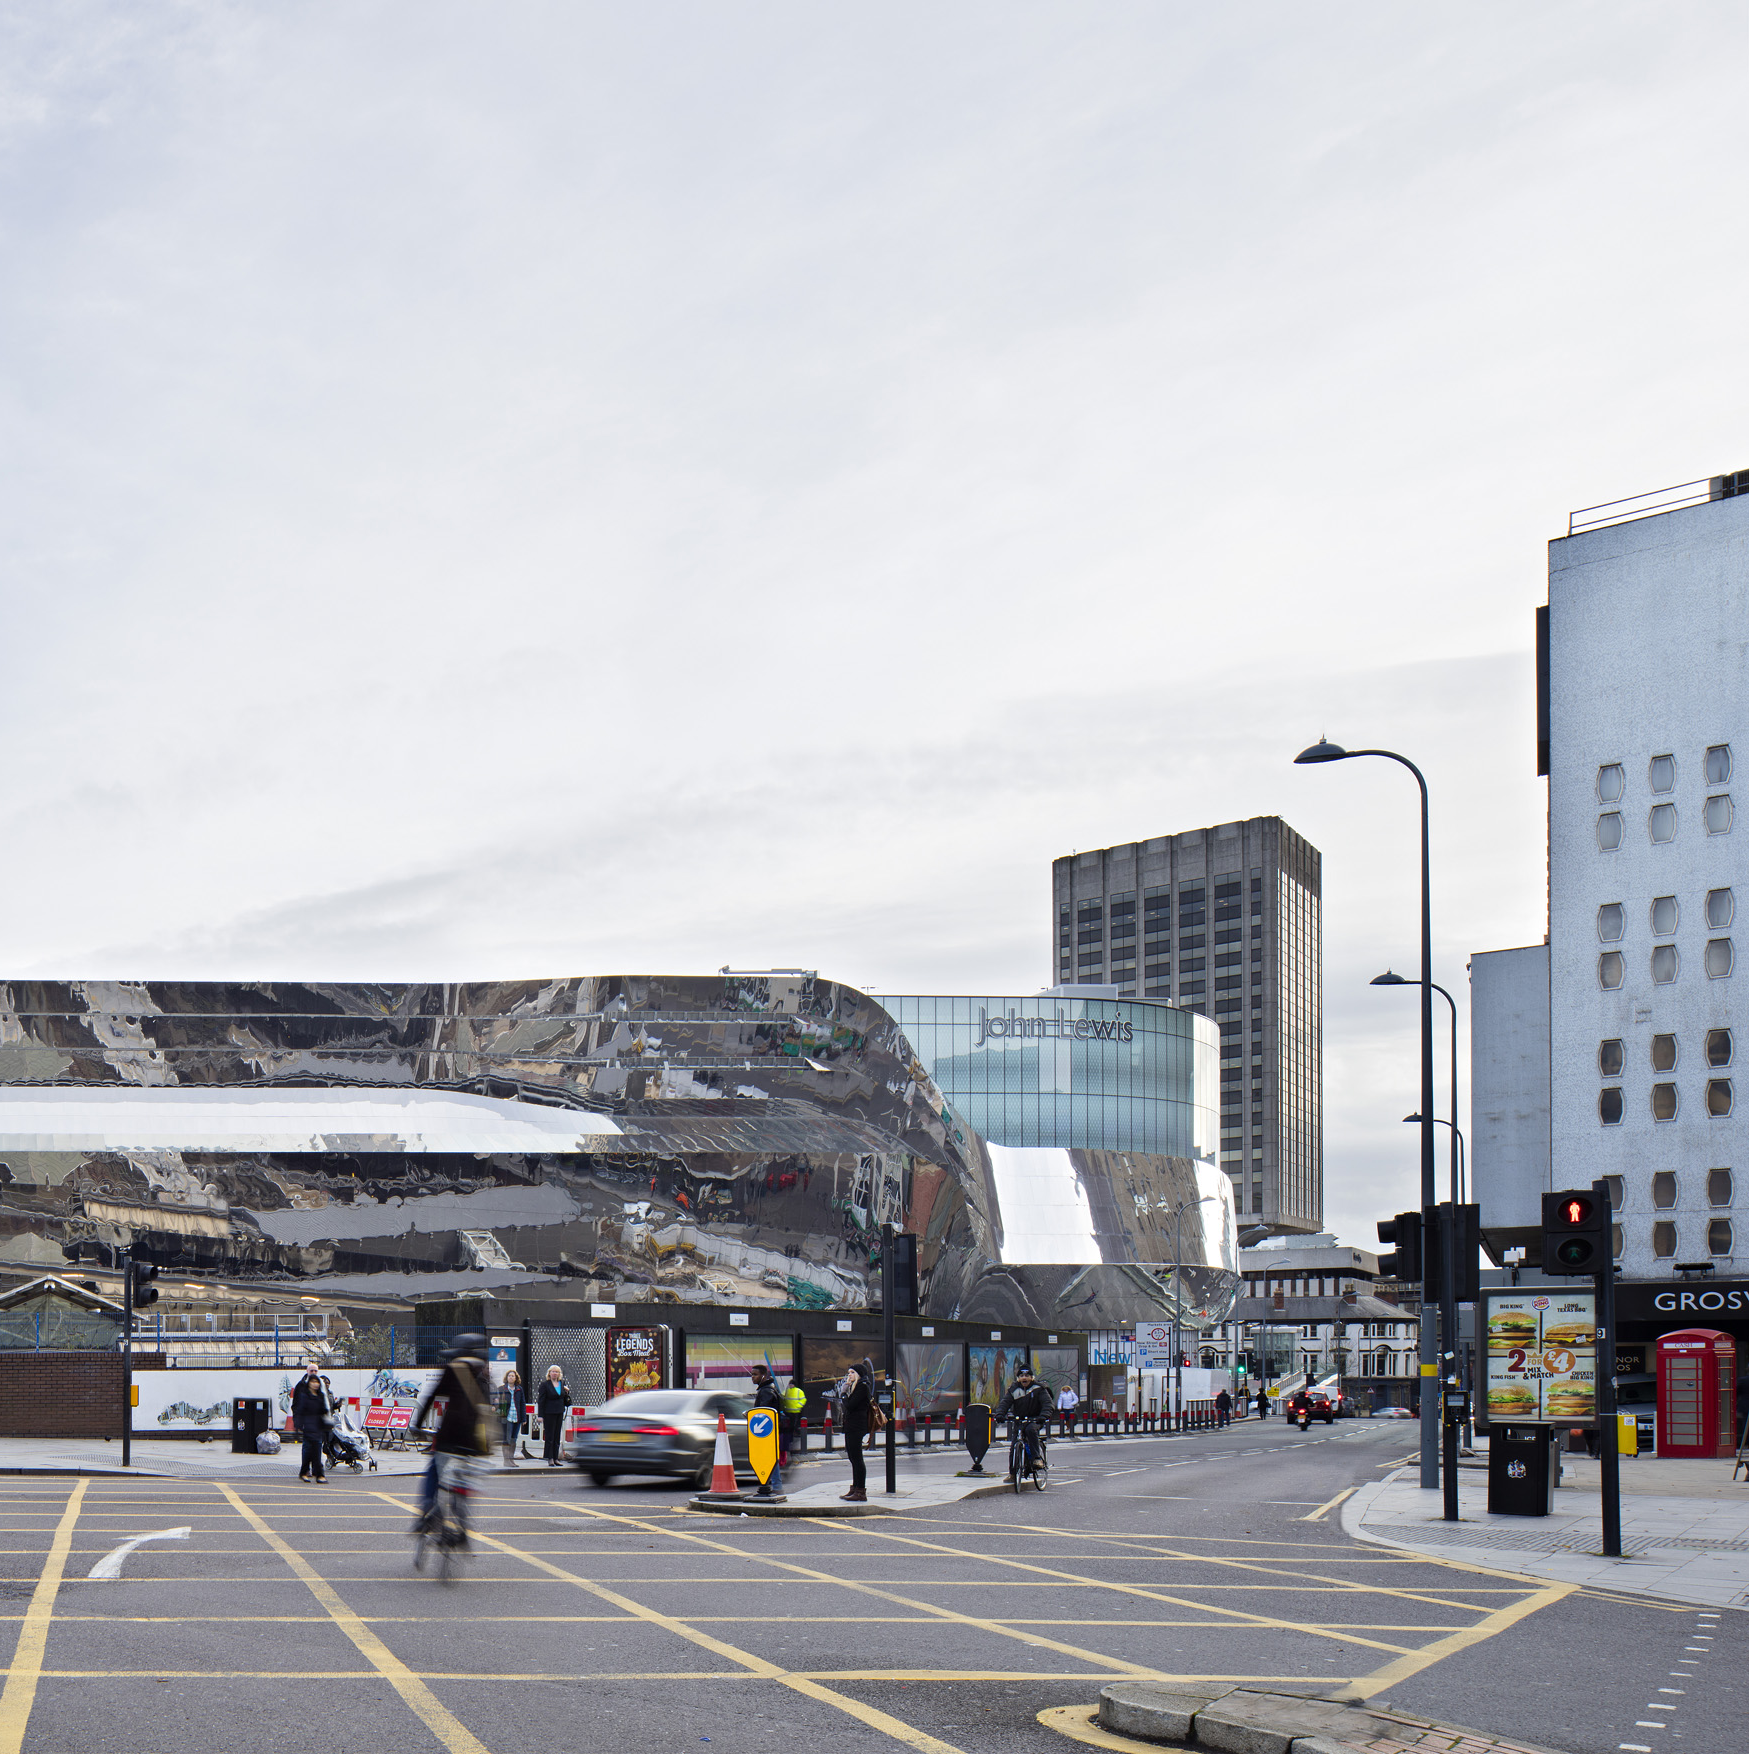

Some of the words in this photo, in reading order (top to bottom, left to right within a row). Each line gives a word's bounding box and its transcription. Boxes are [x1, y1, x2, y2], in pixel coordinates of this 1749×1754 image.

[974, 1005, 1047, 1048] John
[1058, 1006, 1134, 1043] Lewis
[1654, 1290, 1749, 1311] GROS
[617, 1338, 654, 1351] LEGENDS
[1094, 1349, 1131, 1365] New
[1508, 1349, 1526, 1372] 2
[1547, 1351, 1569, 1372] £4
